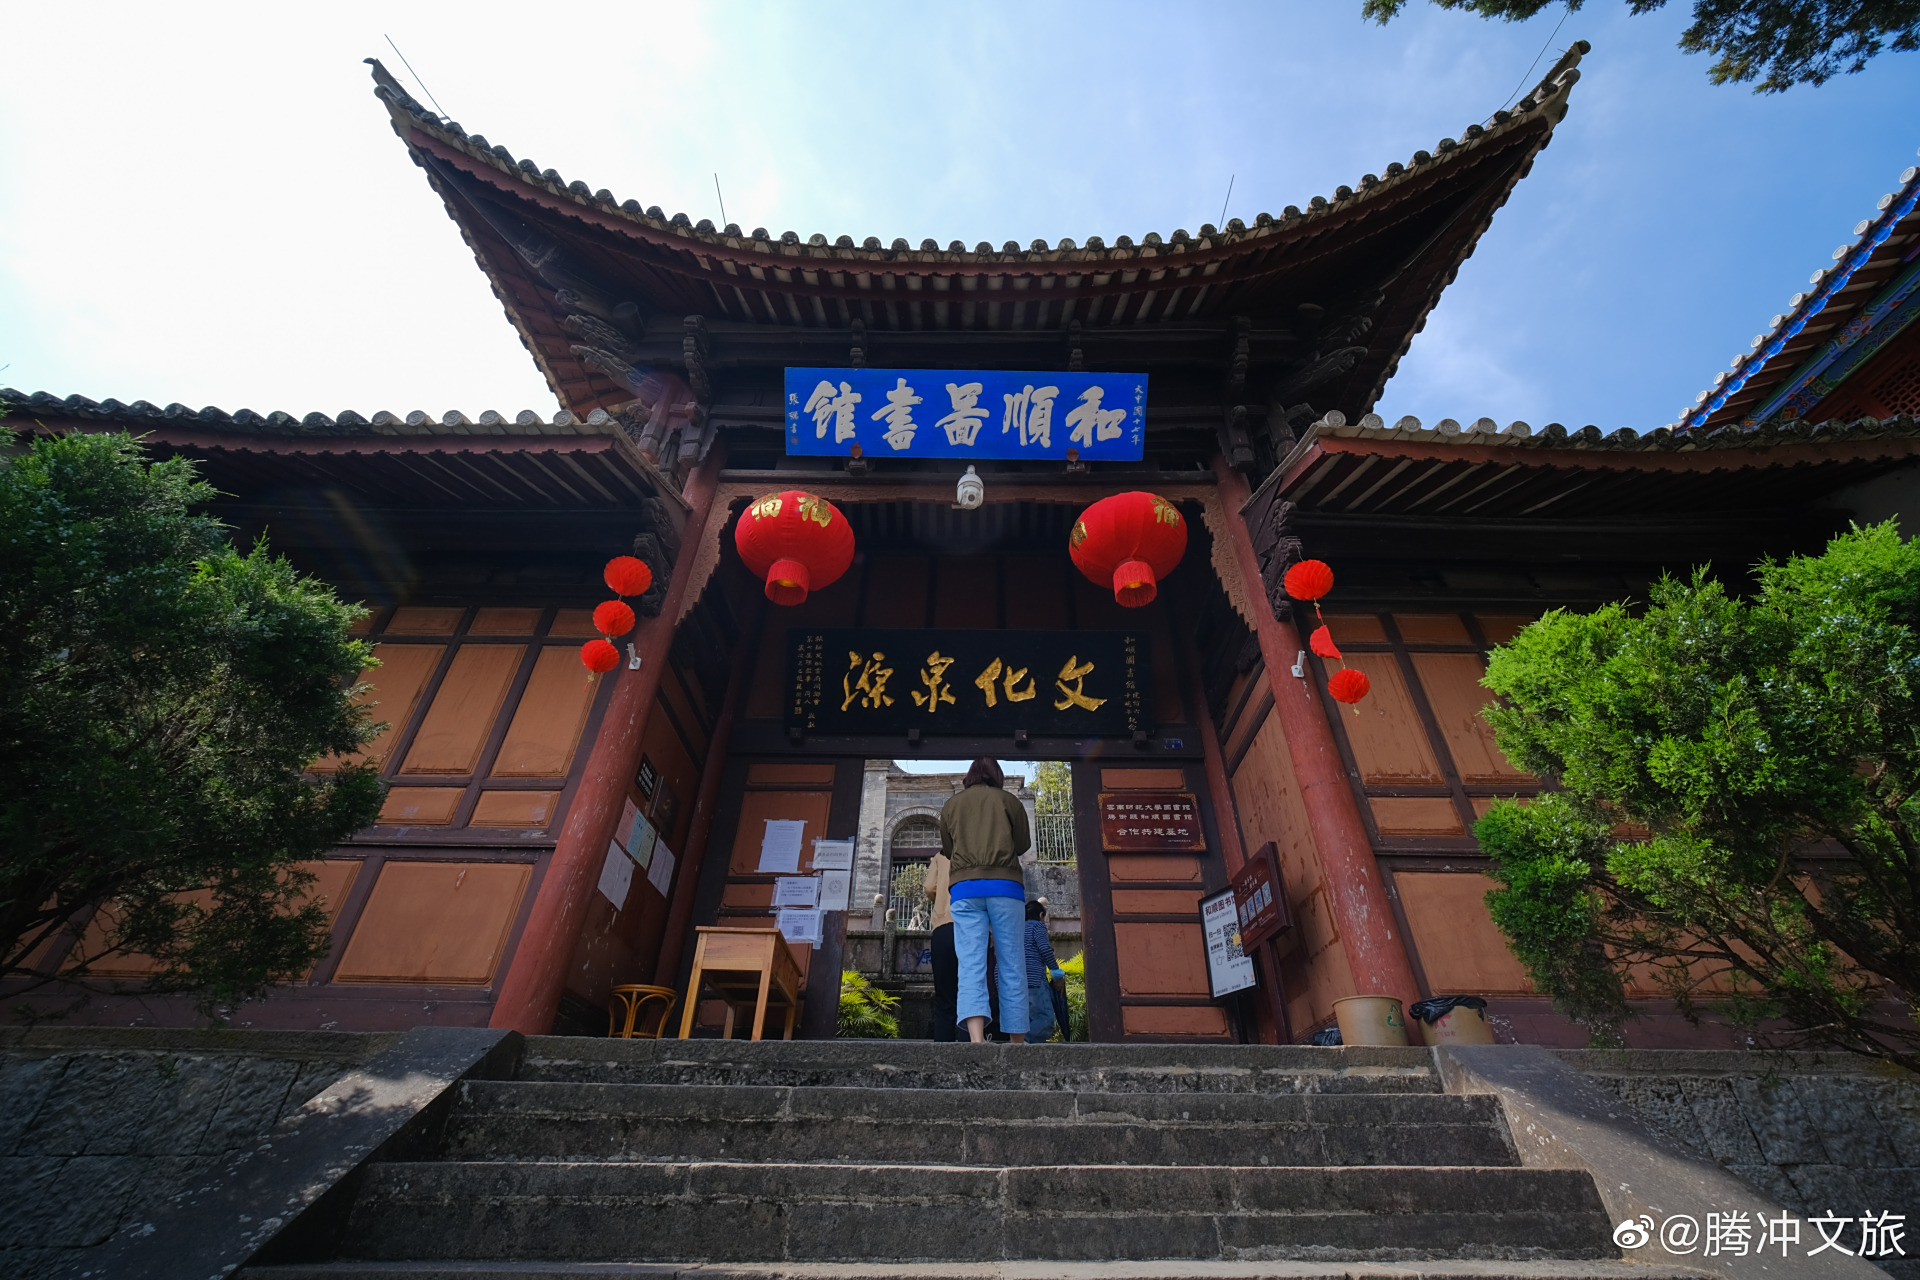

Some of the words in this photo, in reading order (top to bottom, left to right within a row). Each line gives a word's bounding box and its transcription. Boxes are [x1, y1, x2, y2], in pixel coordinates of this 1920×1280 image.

[1116, 828, 1189, 836] 合作共建基地
